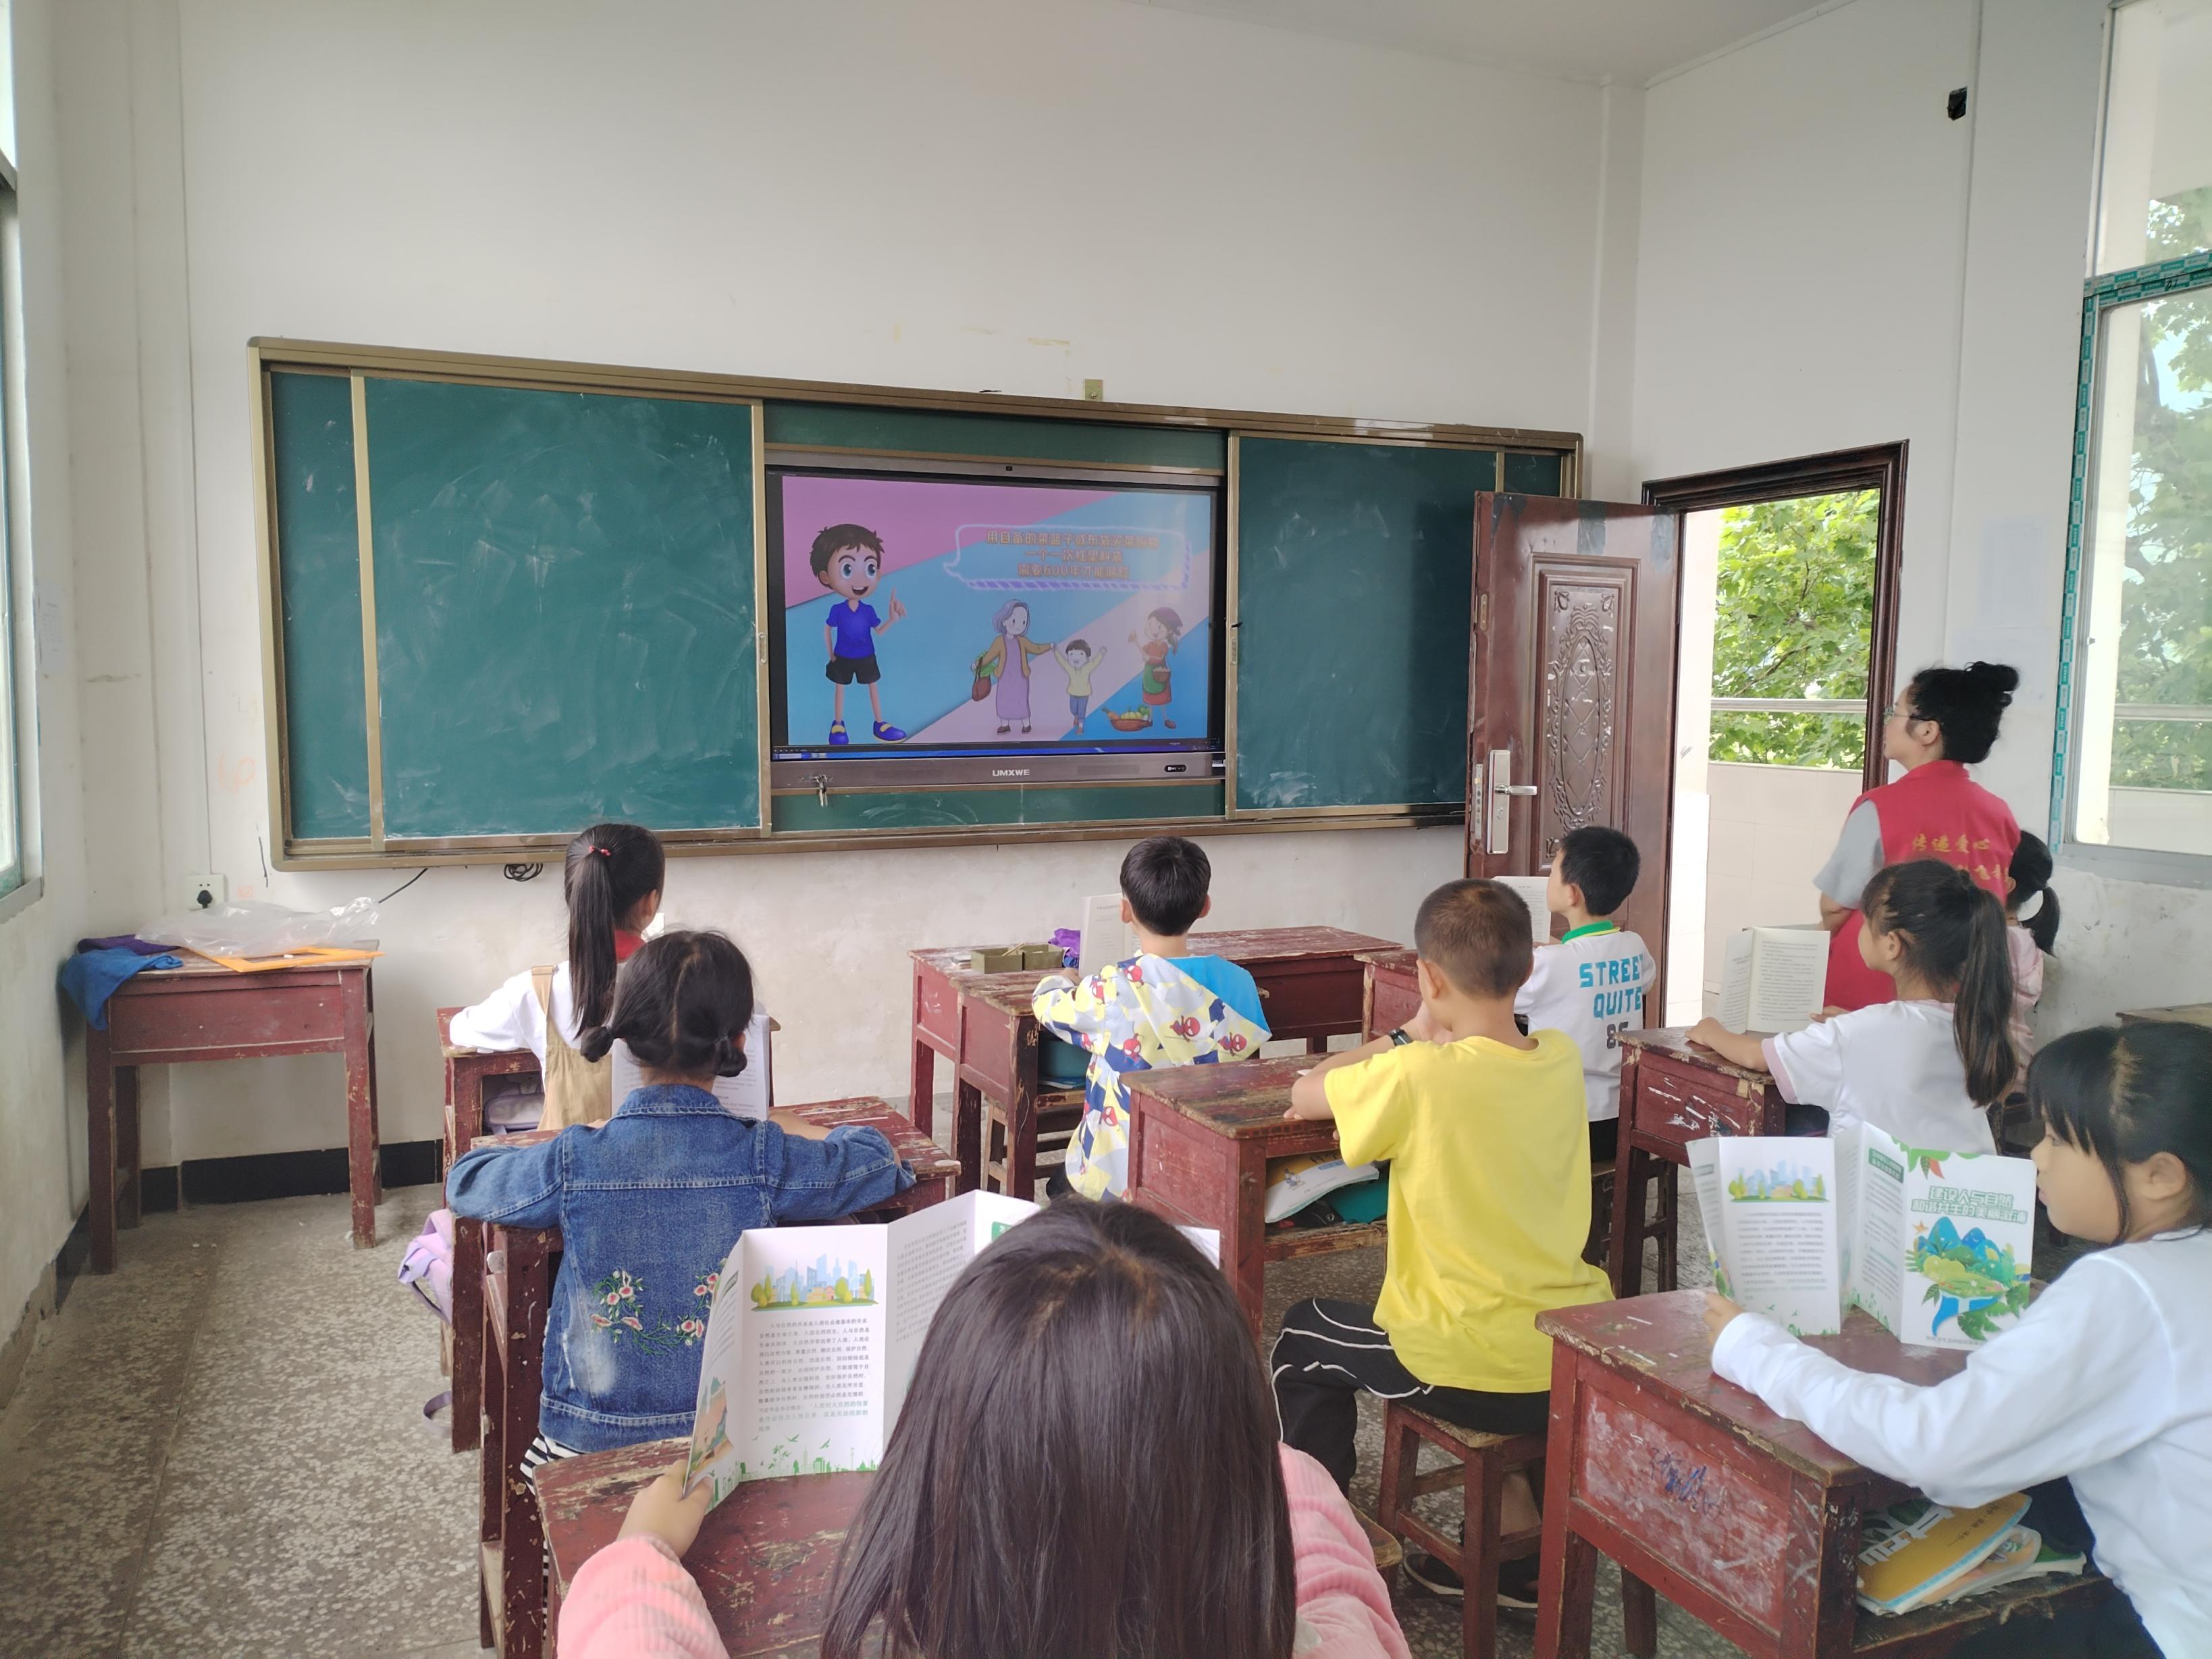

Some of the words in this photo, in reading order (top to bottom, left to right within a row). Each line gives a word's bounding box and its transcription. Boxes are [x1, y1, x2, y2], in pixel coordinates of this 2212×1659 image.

[1594, 986, 1642, 1020] QUITE
[1928, 1185, 2014, 1209] 建设人与自然
[1911, 1199, 2028, 1225] 和谐共生的美丽溆浦
